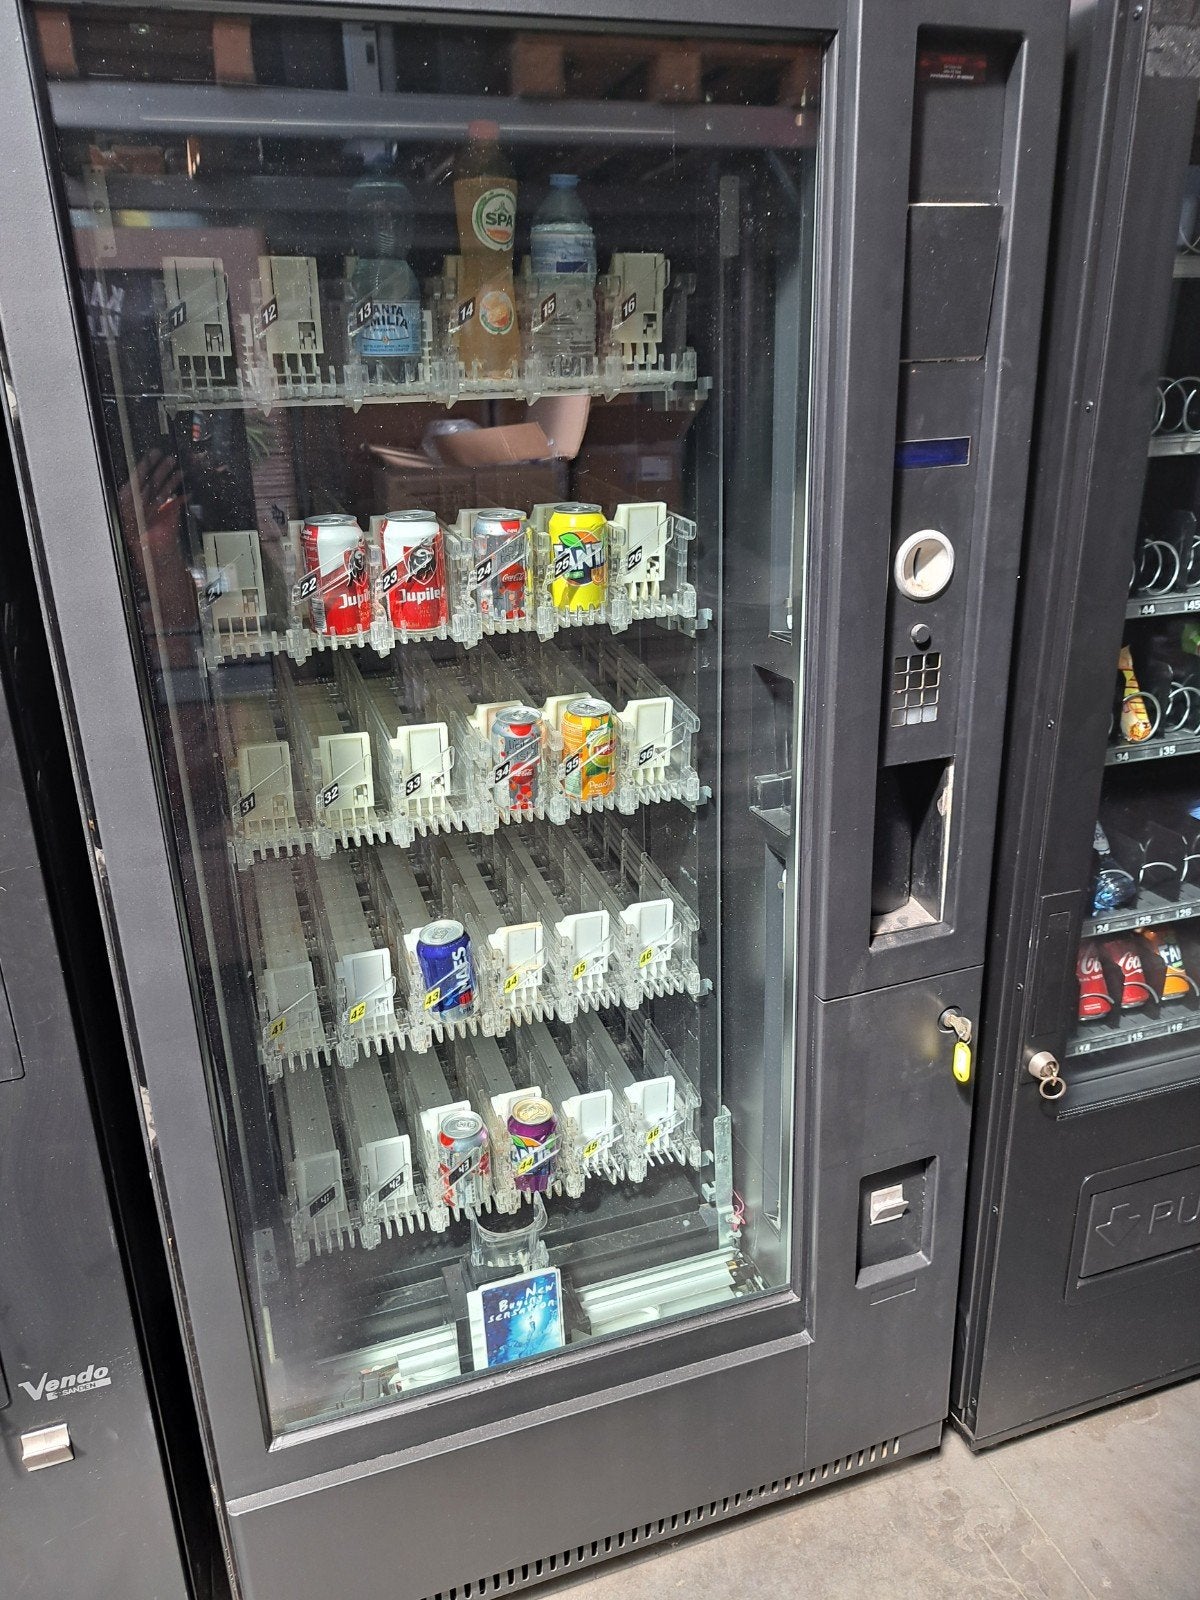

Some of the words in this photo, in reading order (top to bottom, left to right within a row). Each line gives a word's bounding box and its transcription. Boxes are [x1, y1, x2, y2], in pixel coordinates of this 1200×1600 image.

[485, 212, 513, 228] SPA
[262, 303, 277, 325] 12
[358, 302, 372, 322] 13
[372, 303, 404, 317] ANTA
[460, 301, 474, 320] 14
[542, 299, 555, 317] 15
[623, 299, 636, 316] 16
[170, 307, 184, 327] 11
[364, 315, 409, 330] MILIA
[555, 557, 569, 576] 25
[628, 551, 642, 569] 26
[383, 571, 398, 590] 23
[477, 561, 491, 582] 24
[207, 583, 221, 601] 21
[301, 576, 317, 597] 22
[1141, 604, 1155, 615] 44
[639, 747, 654, 764] 36
[1116, 752, 1129, 762] 34
[495, 764, 509, 782] 34
[566, 756, 579, 774] 35
[405, 775, 421, 794] 33
[323, 786, 339, 804] 32
[241, 796, 255, 815] 31
[640, 949, 653, 963] 46
[574, 963, 586, 976] 45
[505, 975, 518, 990] 44
[425, 991, 439, 1005] 43
[350, 1004, 365, 1020] 42
[270, 1021, 285, 1037] 41
[648, 1127, 660, 1140] 46
[584, 1142, 598, 1154] 45
[458, 1159, 470, 1173] 43
[519, 1157, 533, 1170] 44
[389, 1174, 401, 1189] 42
[525, 1281, 555, 1299] New
[487, 1299, 555, 1324] sensation
[498, 1295, 543, 1313] Buying
[17, 1363, 109, 1401] Vendo
[61, 1382, 97, 1396] SANDEN
